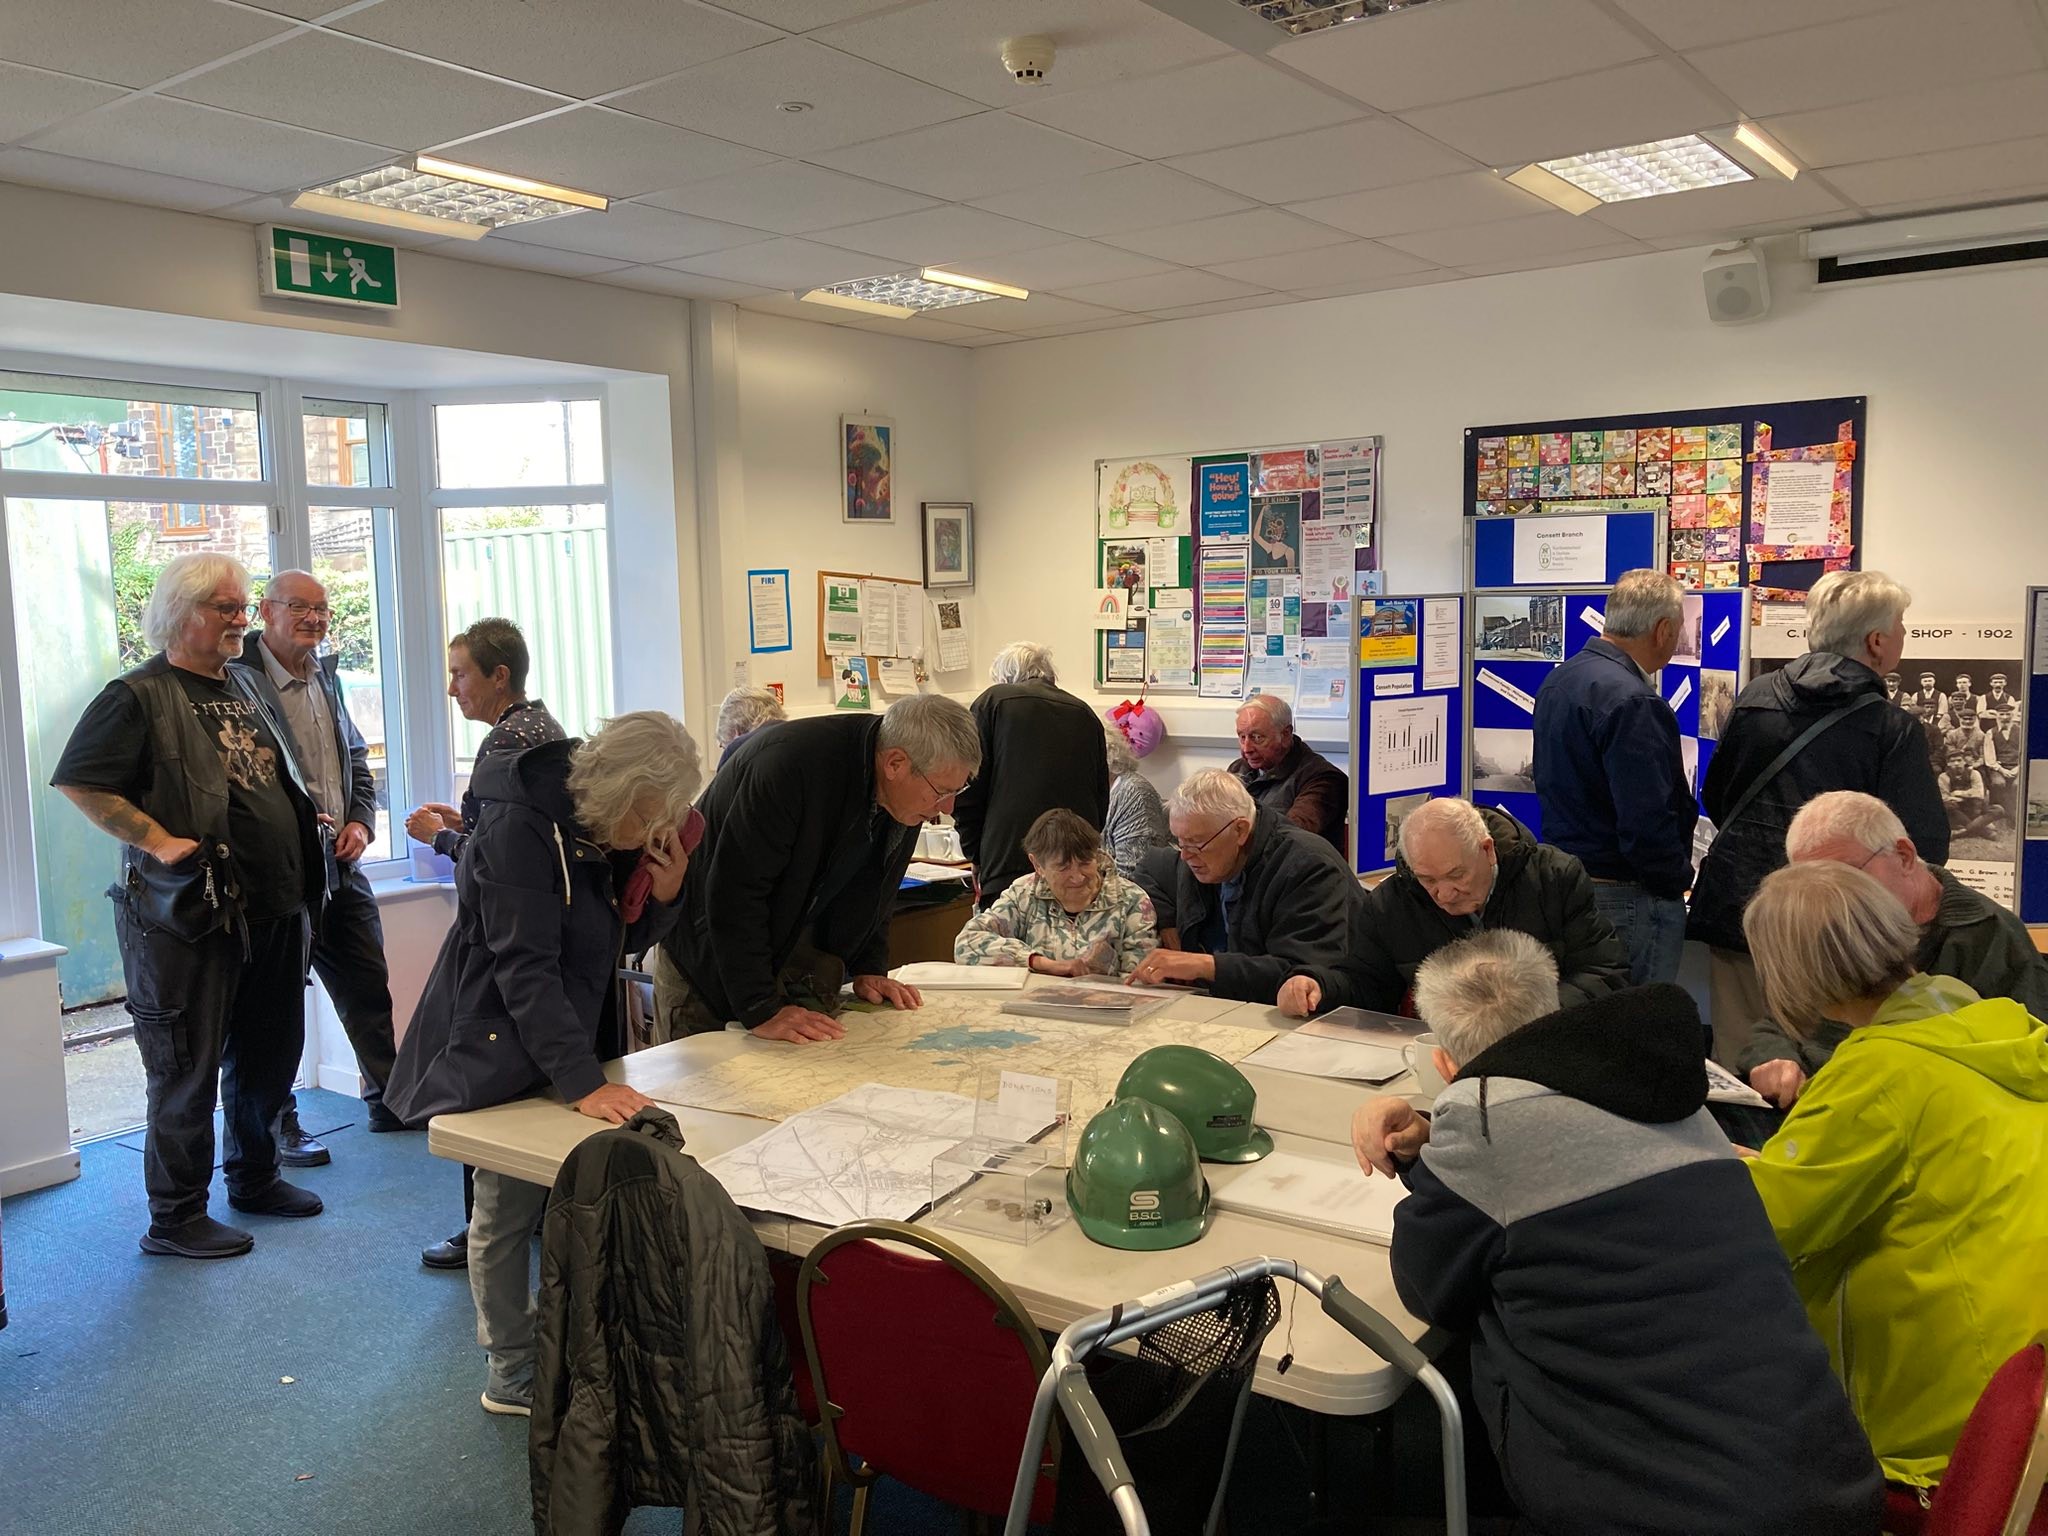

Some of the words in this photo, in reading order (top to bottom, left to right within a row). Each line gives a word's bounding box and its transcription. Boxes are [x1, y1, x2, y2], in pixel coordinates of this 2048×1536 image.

[1209, 483, 1234, 492] How's
[761, 577, 776, 585] FIRE
[1269, 598, 1281, 609] 10
[1786, 629, 1800, 638] C.
[1911, 629, 1953, 638] SHOP
[1977, 629, 2013, 639] 1902
[1392, 682, 1413, 691] Population
[1002, 1080, 1053, 1095] DONATIONS
